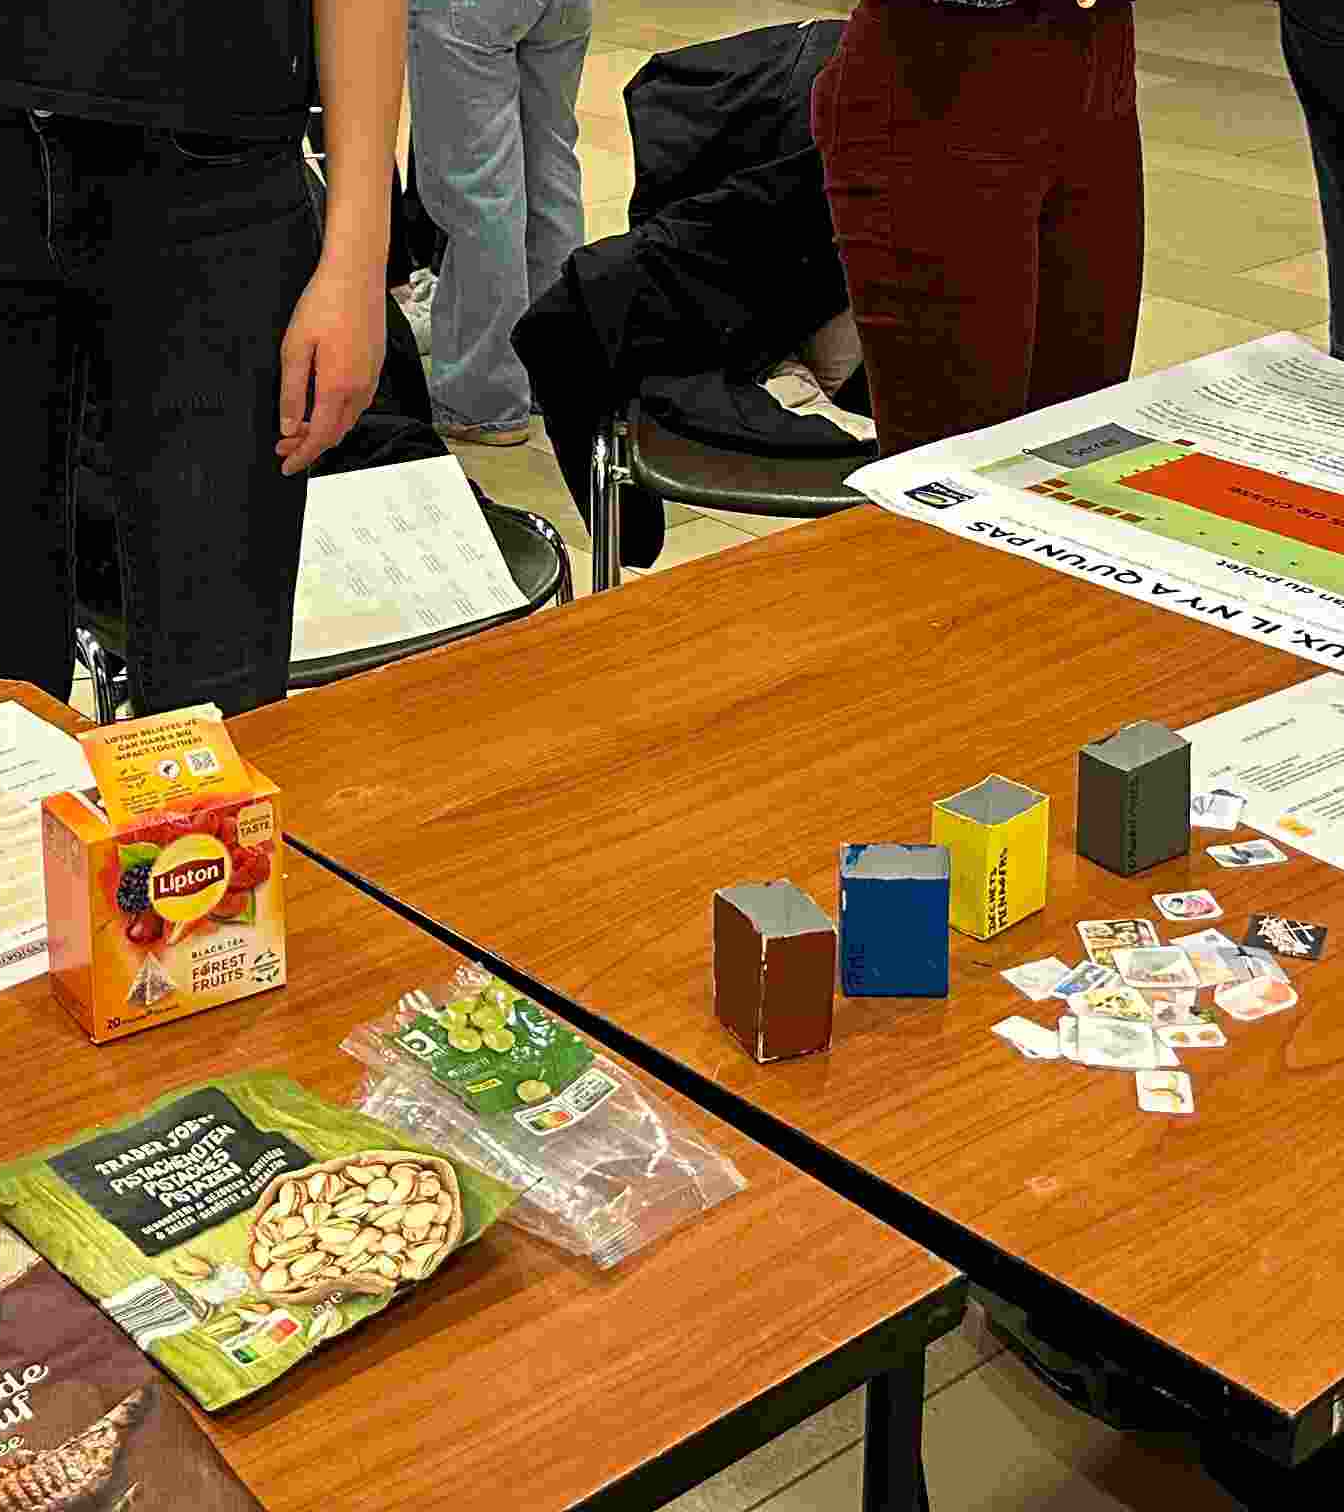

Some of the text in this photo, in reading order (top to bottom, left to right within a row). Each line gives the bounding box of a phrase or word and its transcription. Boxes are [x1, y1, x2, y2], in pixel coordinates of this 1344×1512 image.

[1296, 507, 1327, 520] de
[966, 521, 1033, 548] PAS
[1034, 541, 1144, 586] QU'UN
[1216, 559, 1283, 584] projet
[1151, 581, 1182, 597] A
[1285, 581, 1315, 595] du
[1175, 597, 1243, 622] N'Y
[1249, 615, 1283, 635] IL
[240, 822, 270, 838] TASTE
[159, 863, 219, 894] Lipton
[192, 943, 222, 961] BLACK
[192, 951, 246, 981] FOREST
[192, 969, 244, 993] FRUITS
[94, 1140, 168, 1176] TRADER
[110, 1125, 236, 1195] PISTACHENOTEN
[143, 1148, 230, 1198] PISTACHES
[159, 1162, 242, 1208] PISTAZEN
